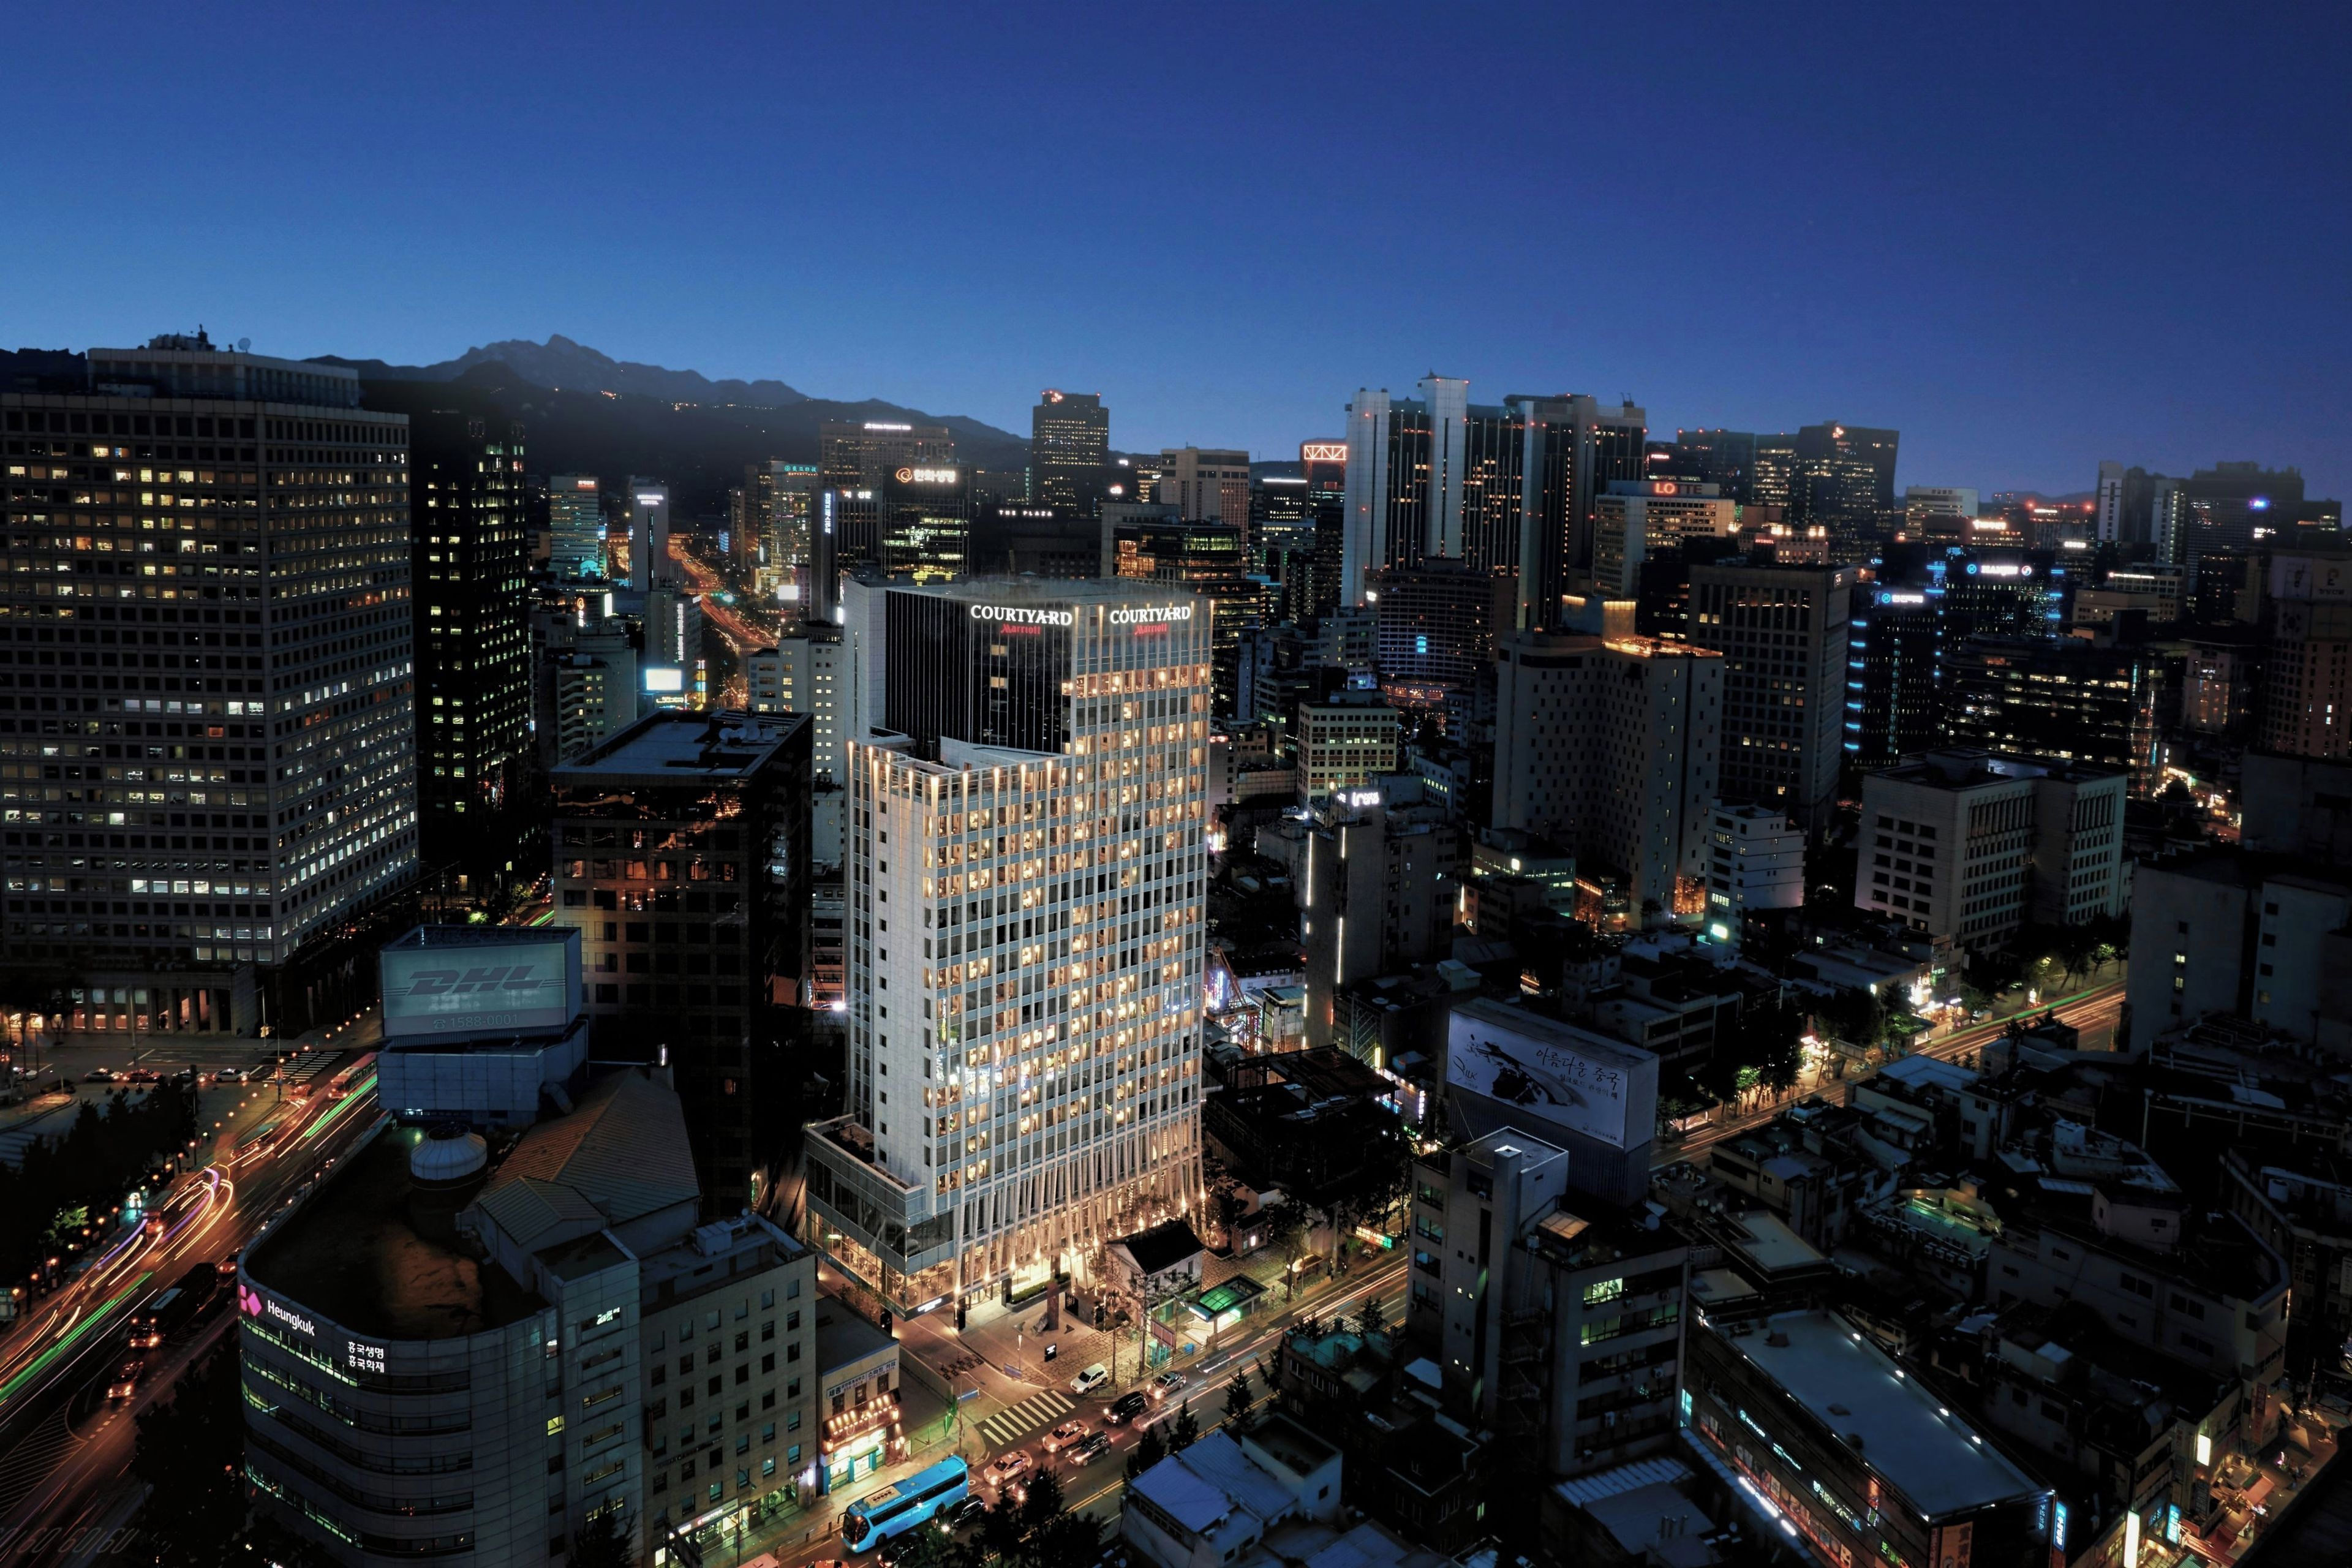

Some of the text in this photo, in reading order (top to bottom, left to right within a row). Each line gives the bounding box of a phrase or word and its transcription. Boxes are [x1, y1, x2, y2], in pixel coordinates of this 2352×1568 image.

[1655, 483, 1703, 494] LOTTE
[970, 605, 1072, 626] COURTYARD
[1109, 607, 1191, 624] COURTYARD
[1000, 624, 1041, 635] Marriott
[1134, 624, 1167, 636] Marriott
[407, 965, 543, 995] DHL
[450, 1014, 518, 1029] 1588-0001
[1536, 1047, 1620, 1090] 아름다운 중국
[268, 1299, 315, 1336] Heungkuk
[348, 1341, 384, 1360] 흥국생명
[348, 1355, 385, 1373] 흥국화재
